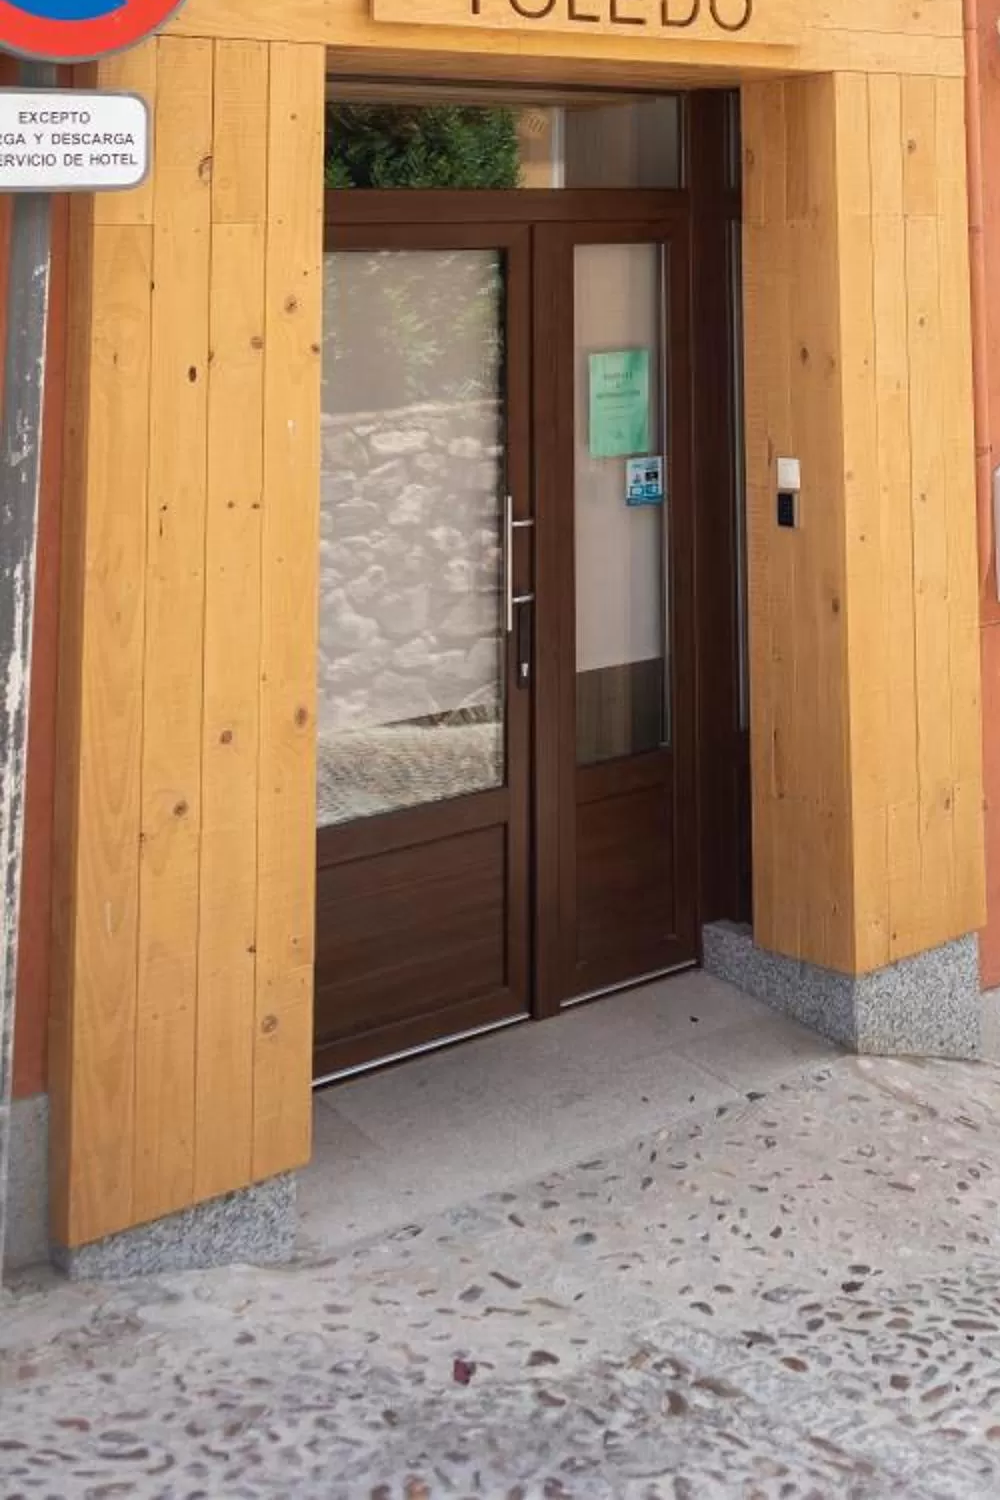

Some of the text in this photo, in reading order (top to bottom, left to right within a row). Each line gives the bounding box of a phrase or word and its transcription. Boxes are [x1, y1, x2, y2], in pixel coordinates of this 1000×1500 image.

[18, 111, 91, 125] EXCEPTO
[0, 133, 135, 145] GA Y DESCARGA
[63, 153, 83, 166] DE
[89, 153, 138, 165] HOTEL
